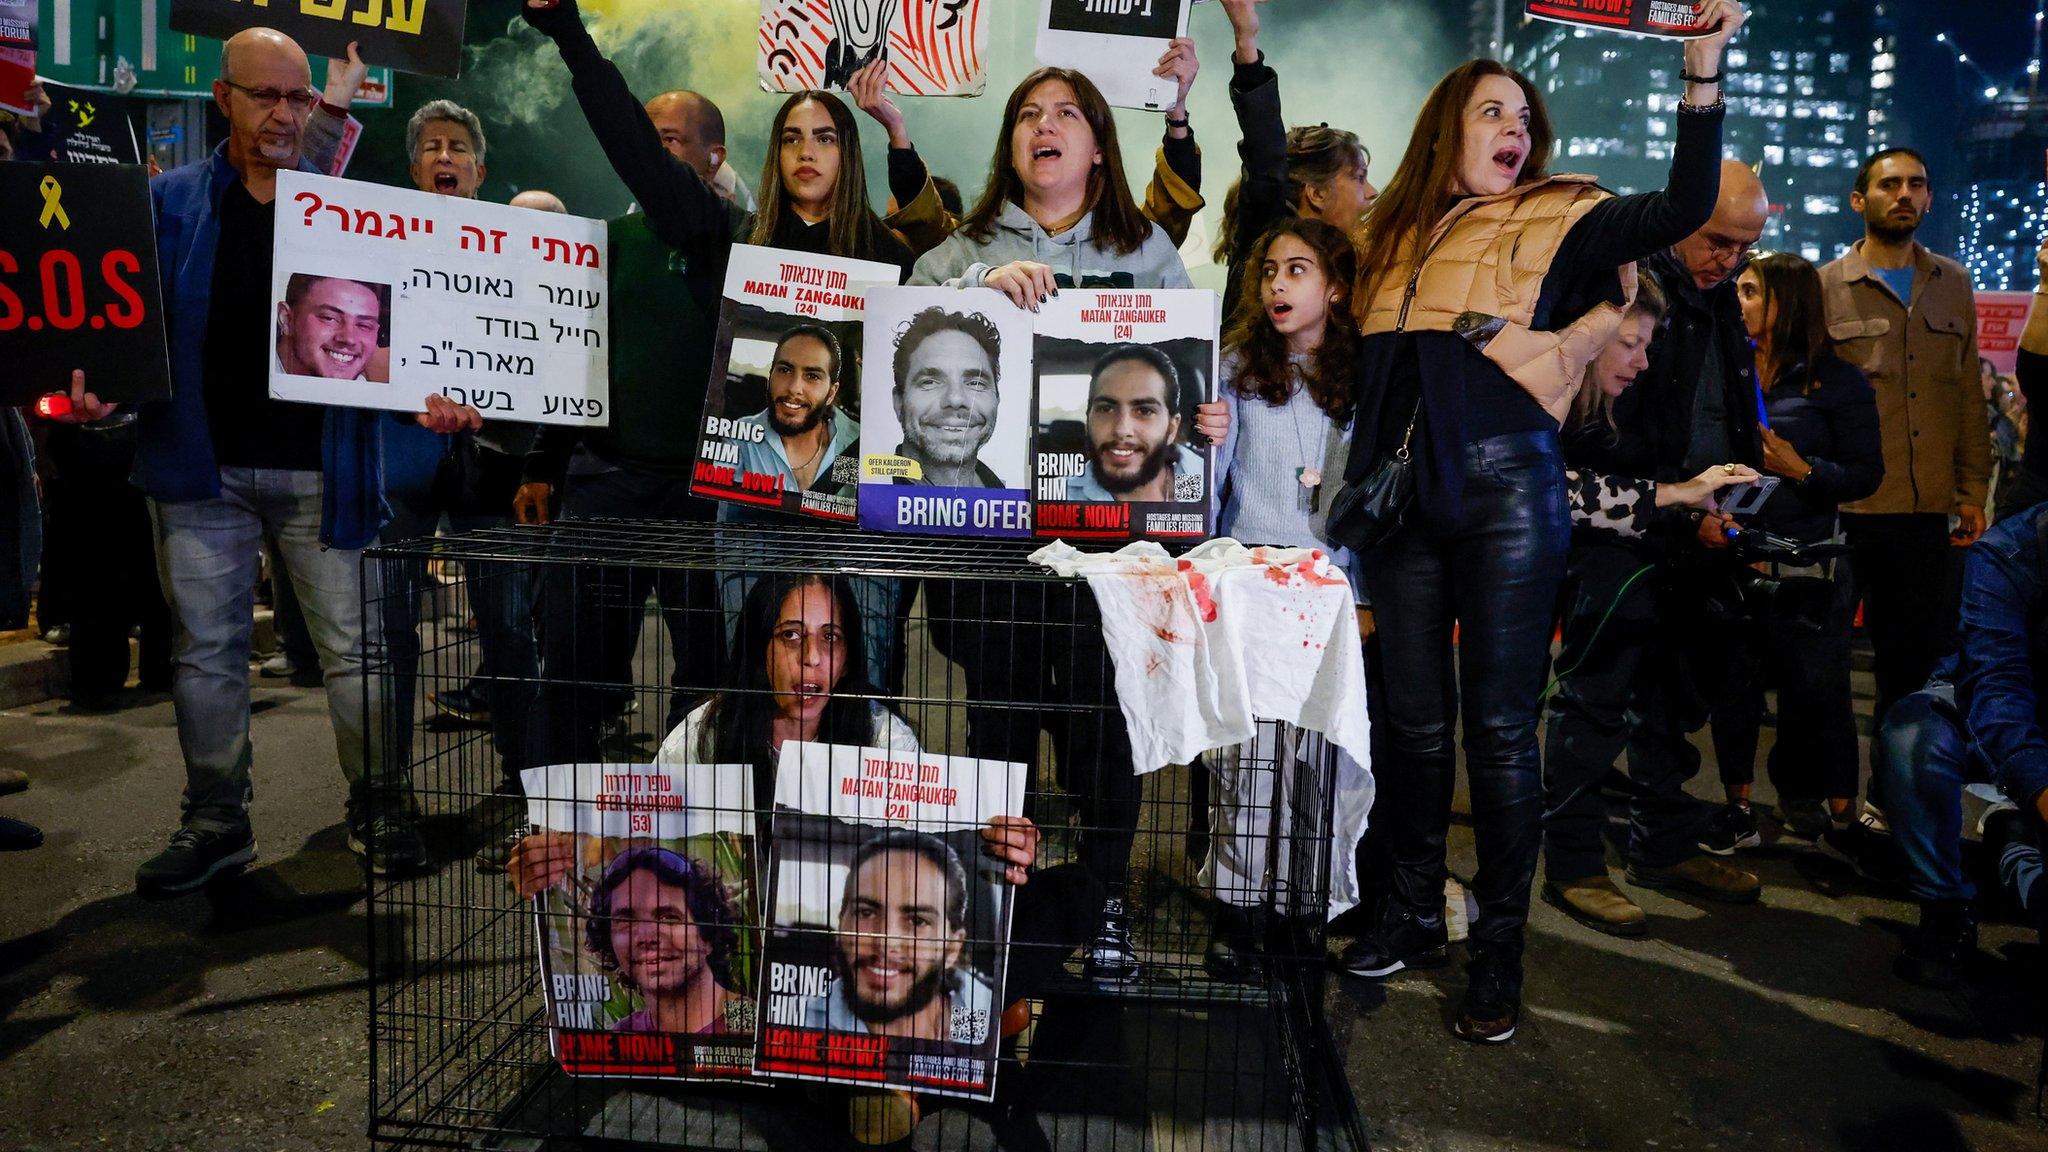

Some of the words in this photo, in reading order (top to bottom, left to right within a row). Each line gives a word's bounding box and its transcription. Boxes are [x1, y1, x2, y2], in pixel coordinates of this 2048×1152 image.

[1648, 10, 1683, 26] FAMILIES
[0, 26, 30, 40] FORUM
[294, 191, 434, 241] ייגמר?
[460, 224, 508, 255] זה
[530, 235, 600, 269] מתי
[402, 268, 514, 299] נאוטרה,
[780, 263, 825, 287] צנגאוקר
[825, 269, 848, 290] מתן
[0, 249, 146, 331] S.O.S
[538, 283, 600, 310] עומר
[743, 280, 788, 299] MATAN
[1096, 294, 1133, 309] צנגאוקר
[795, 302, 818, 316] (24)
[1135, 294, 1152, 310] מתן
[1081, 309, 1112, 323] MATAN
[1114, 309, 1167, 323] ZANGAUKER
[476, 315, 540, 342] בודד
[549, 318, 601, 349] חייל
[1114, 325, 1133, 340] (24)
[420, 340, 535, 376] מארה"ב
[542, 394, 604, 418] פצוע
[705, 415, 765, 443] BRING
[701, 440, 739, 464] HIM
[868, 458, 883, 466] OFER
[883, 458, 912, 467] KALDERON
[693, 461, 736, 487] HOME
[886, 468, 909, 477] CAPTIVE
[1038, 452, 1085, 477] BRING
[802, 489, 827, 502] HOSTAGES
[1038, 477, 1068, 501] HIM
[801, 499, 832, 514] FAMILIES
[832, 503, 857, 517] FORUM
[897, 496, 967, 528] BRING
[973, 498, 1032, 530] OFER
[1037, 503, 1081, 528] HOME
[1084, 502, 1130, 529] NOW!
[1146, 513, 1171, 522] HOSTAGES
[1171, 513, 1182, 522] AND
[1182, 513, 1204, 522] MISSING
[1146, 521, 1177, 533] FAMILIES
[1177, 521, 1204, 533] FORUM
[864, 758, 914, 781] צנגאוקר
[918, 763, 940, 784] מת
[604, 774, 641, 793] קדרון
[645, 775, 672, 792] עופר
[841, 777, 884, 800] MATAN
[886, 783, 957, 807] ZANGAUKER
[596, 794, 623, 812] OFER
[625, 794, 683, 813] KALDERON
[552, 973, 611, 1002] BRING
[771, 961, 833, 998] BRING
[556, 1001, 595, 1030] HIM
[766, 993, 808, 1027] HIM
[616, 1033, 675, 1063] NOW!
[764, 1027, 823, 1061] HOME
[827, 1033, 891, 1071] NOW!
[942, 1056, 956, 1068] AND
